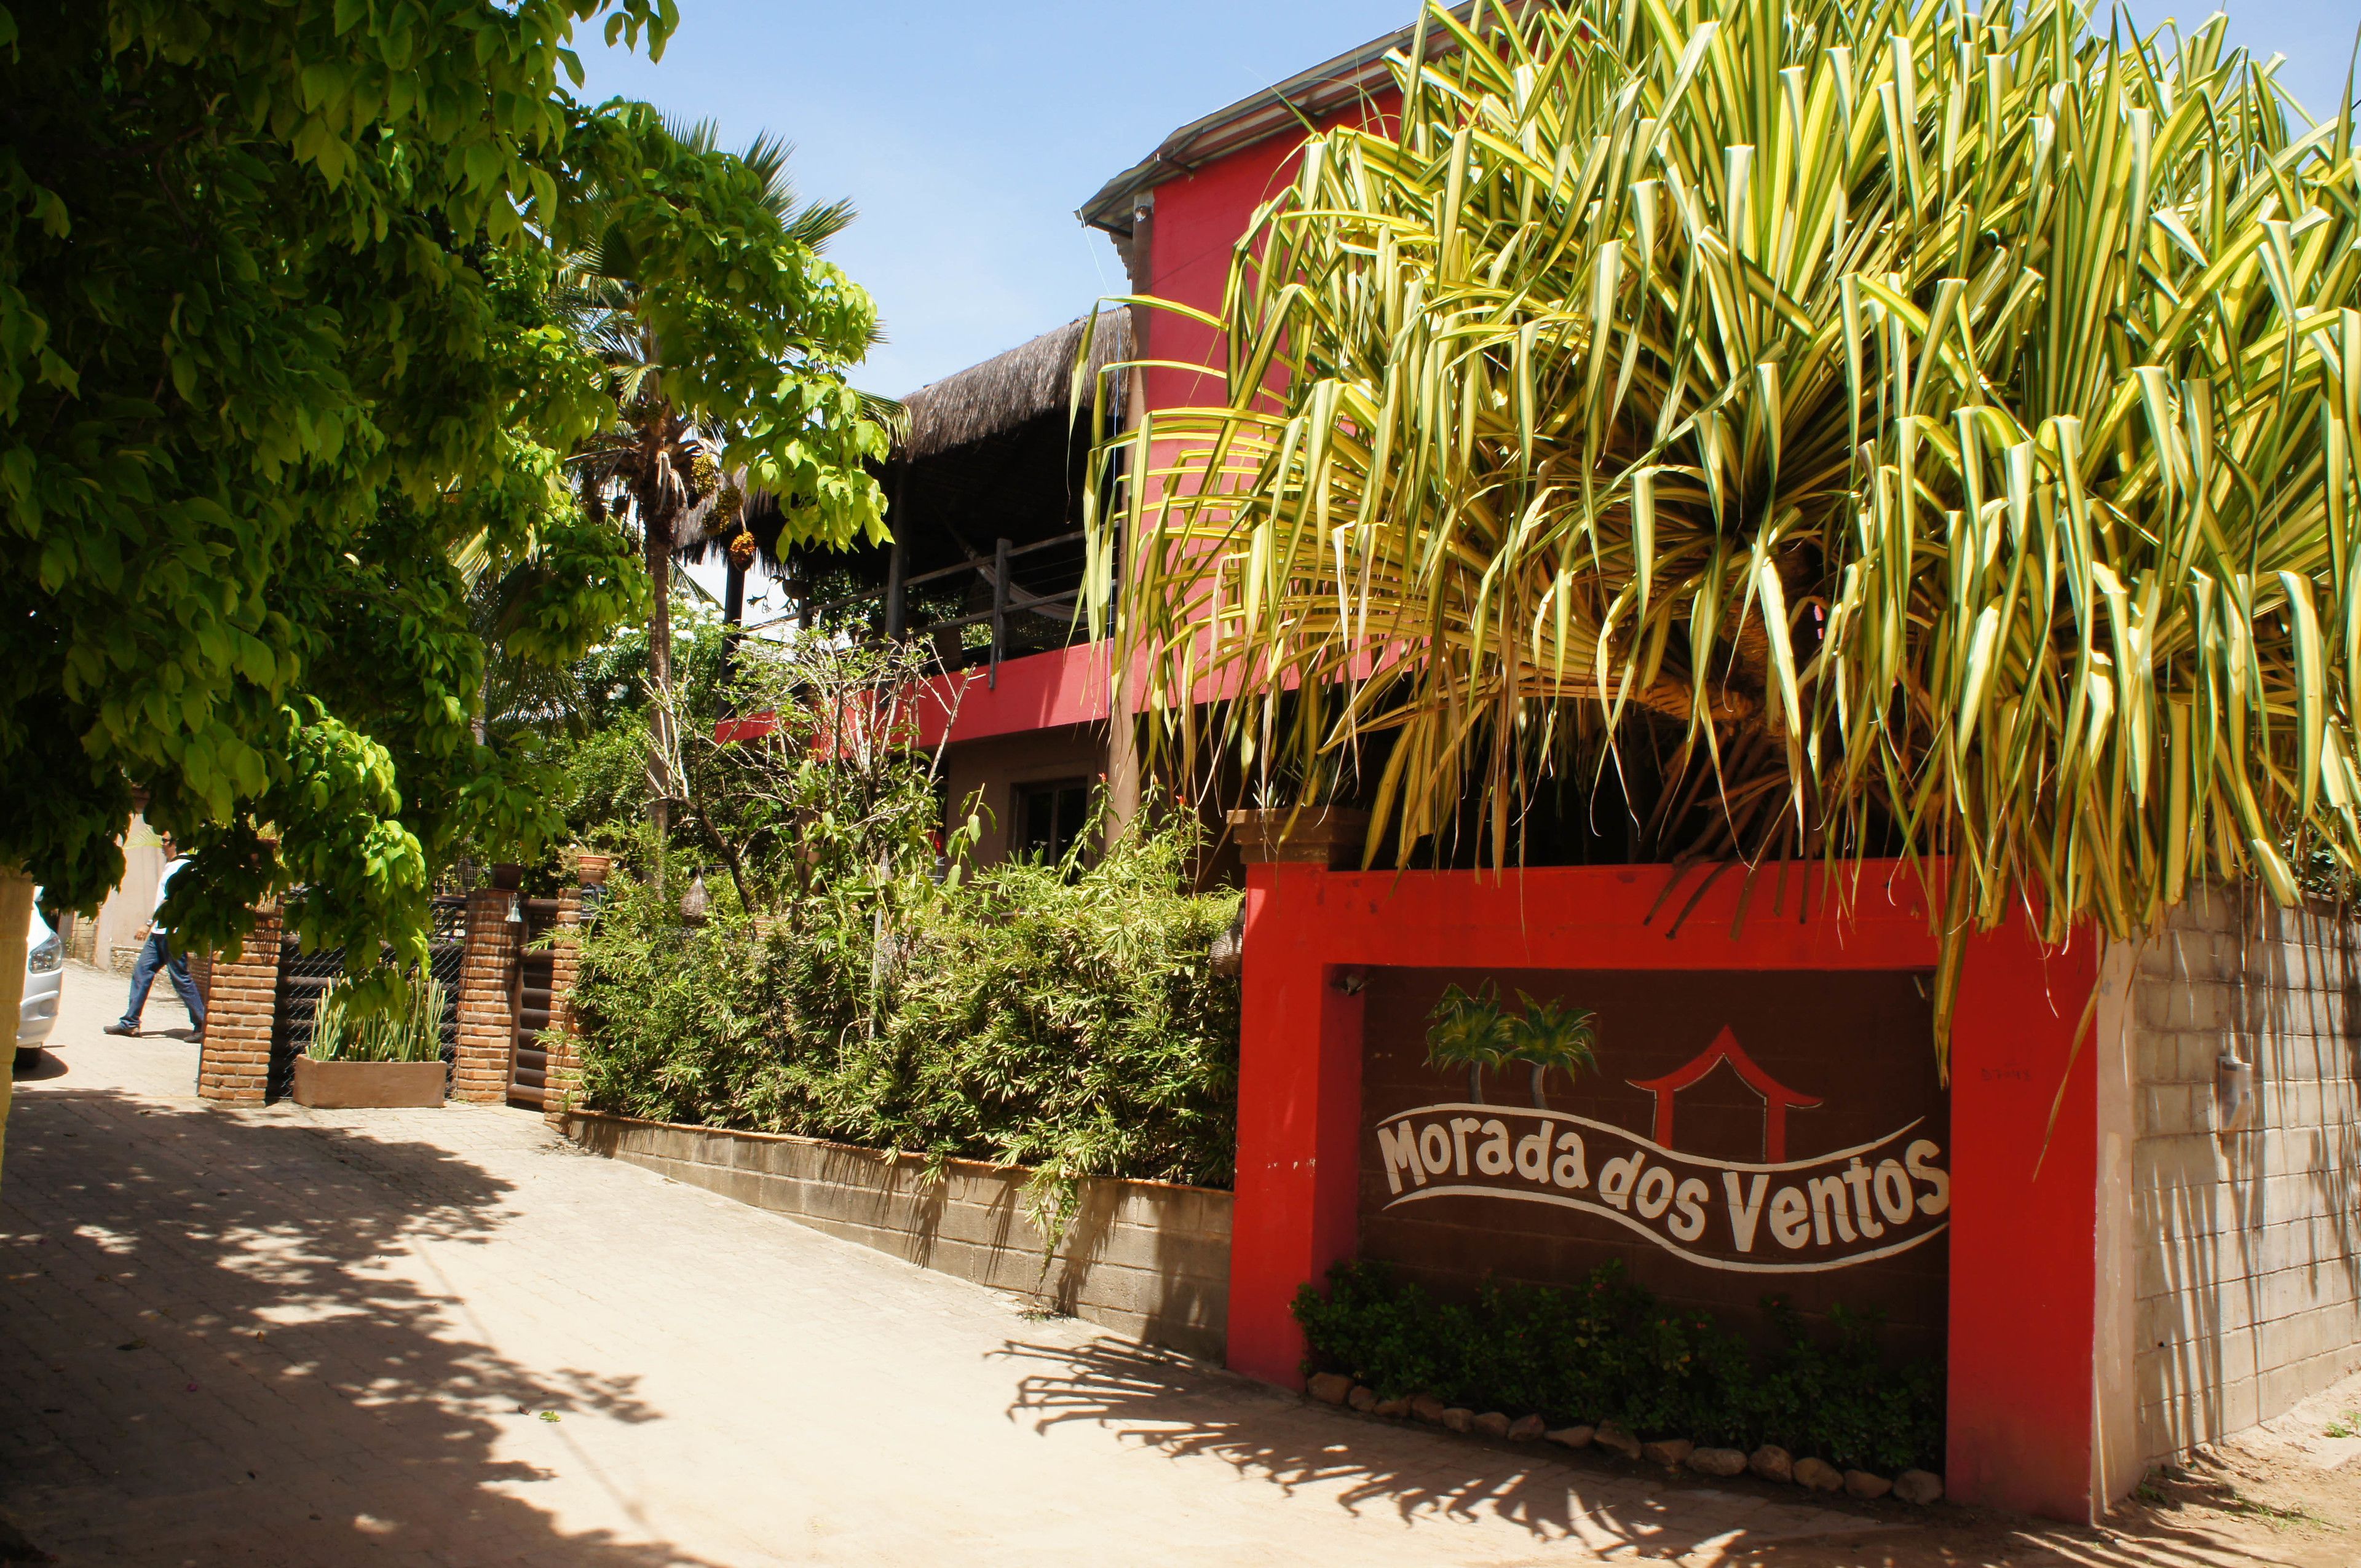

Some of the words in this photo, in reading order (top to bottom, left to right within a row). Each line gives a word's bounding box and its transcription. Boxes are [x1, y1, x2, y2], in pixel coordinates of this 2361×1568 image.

[1377, 1117, 1589, 1195] Morada
[1598, 1151, 1709, 1241] dos
[1722, 1139, 1950, 1252] Ventos
